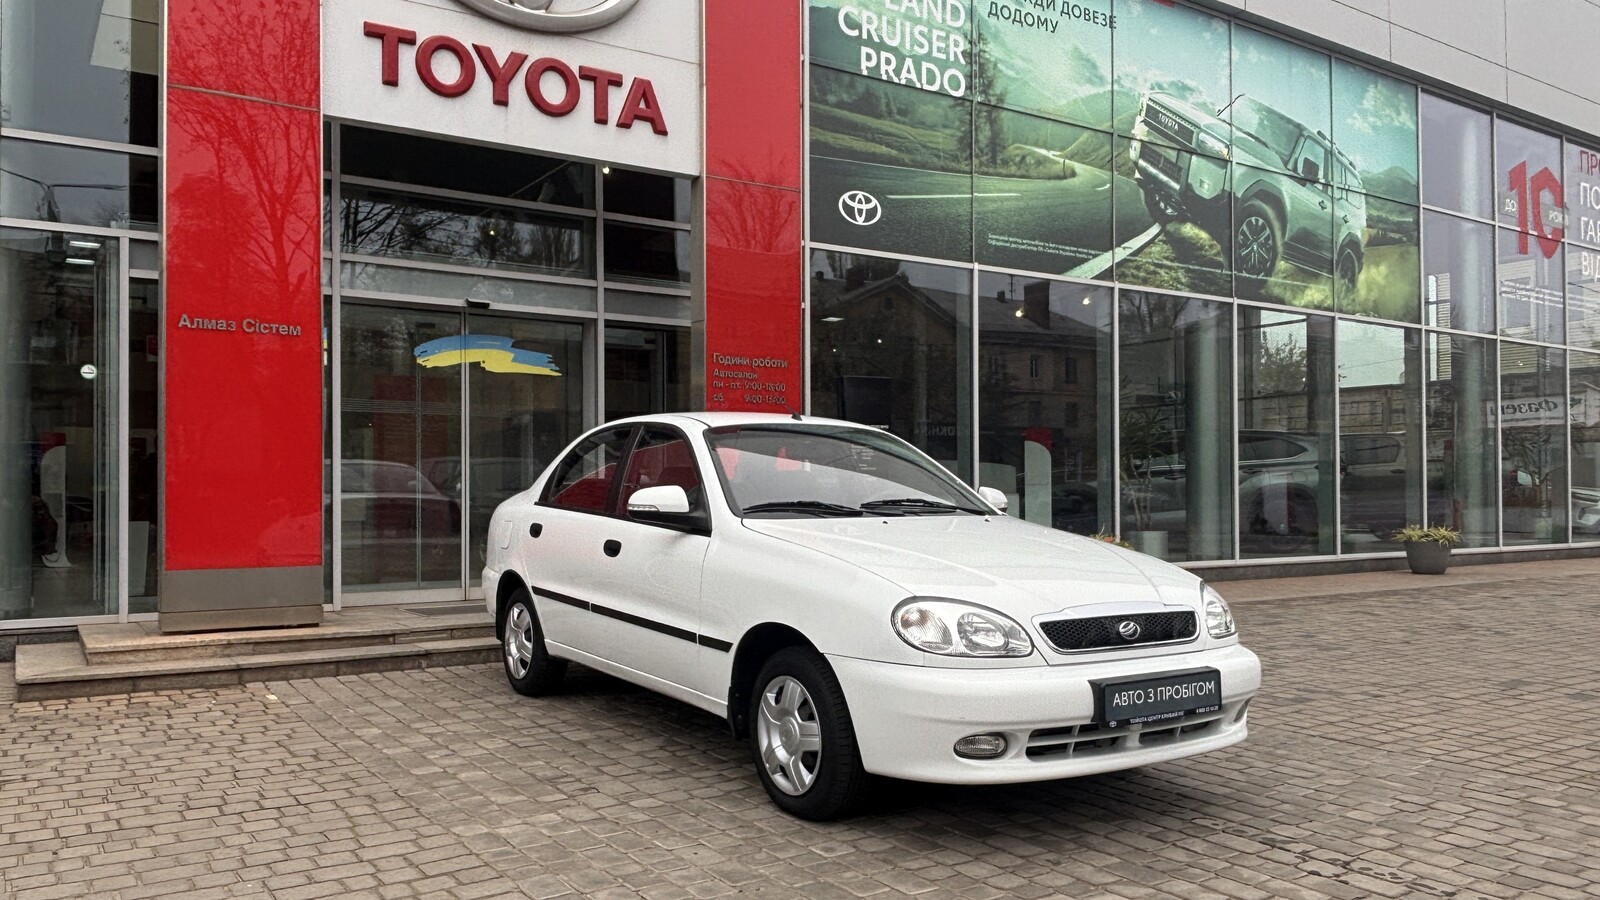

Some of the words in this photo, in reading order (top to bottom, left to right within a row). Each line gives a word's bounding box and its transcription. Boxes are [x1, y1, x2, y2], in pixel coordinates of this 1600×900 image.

[988, 1, 1059, 34] ДОДОМУ
[1060, 0, 1117, 29] ДОВЕЗЕ
[838, 5, 966, 65] CRUISER
[363, 21, 668, 136] TOYOTA
[860, 46, 966, 98] PRADO
[1158, 113, 1179, 131] TOYOTA
[1579, 150, 1600, 177] ПР
[178, 313, 237, 331] Алмаз
[242, 318, 302, 336] Сістем
[713, 352, 750, 367] Години
[752, 356, 788, 369] роботи
[713, 368, 758, 380] Автосалон
[1112, 690, 1145, 708] АВТО
[1157, 681, 1216, 702] ПРОБІГОМ
